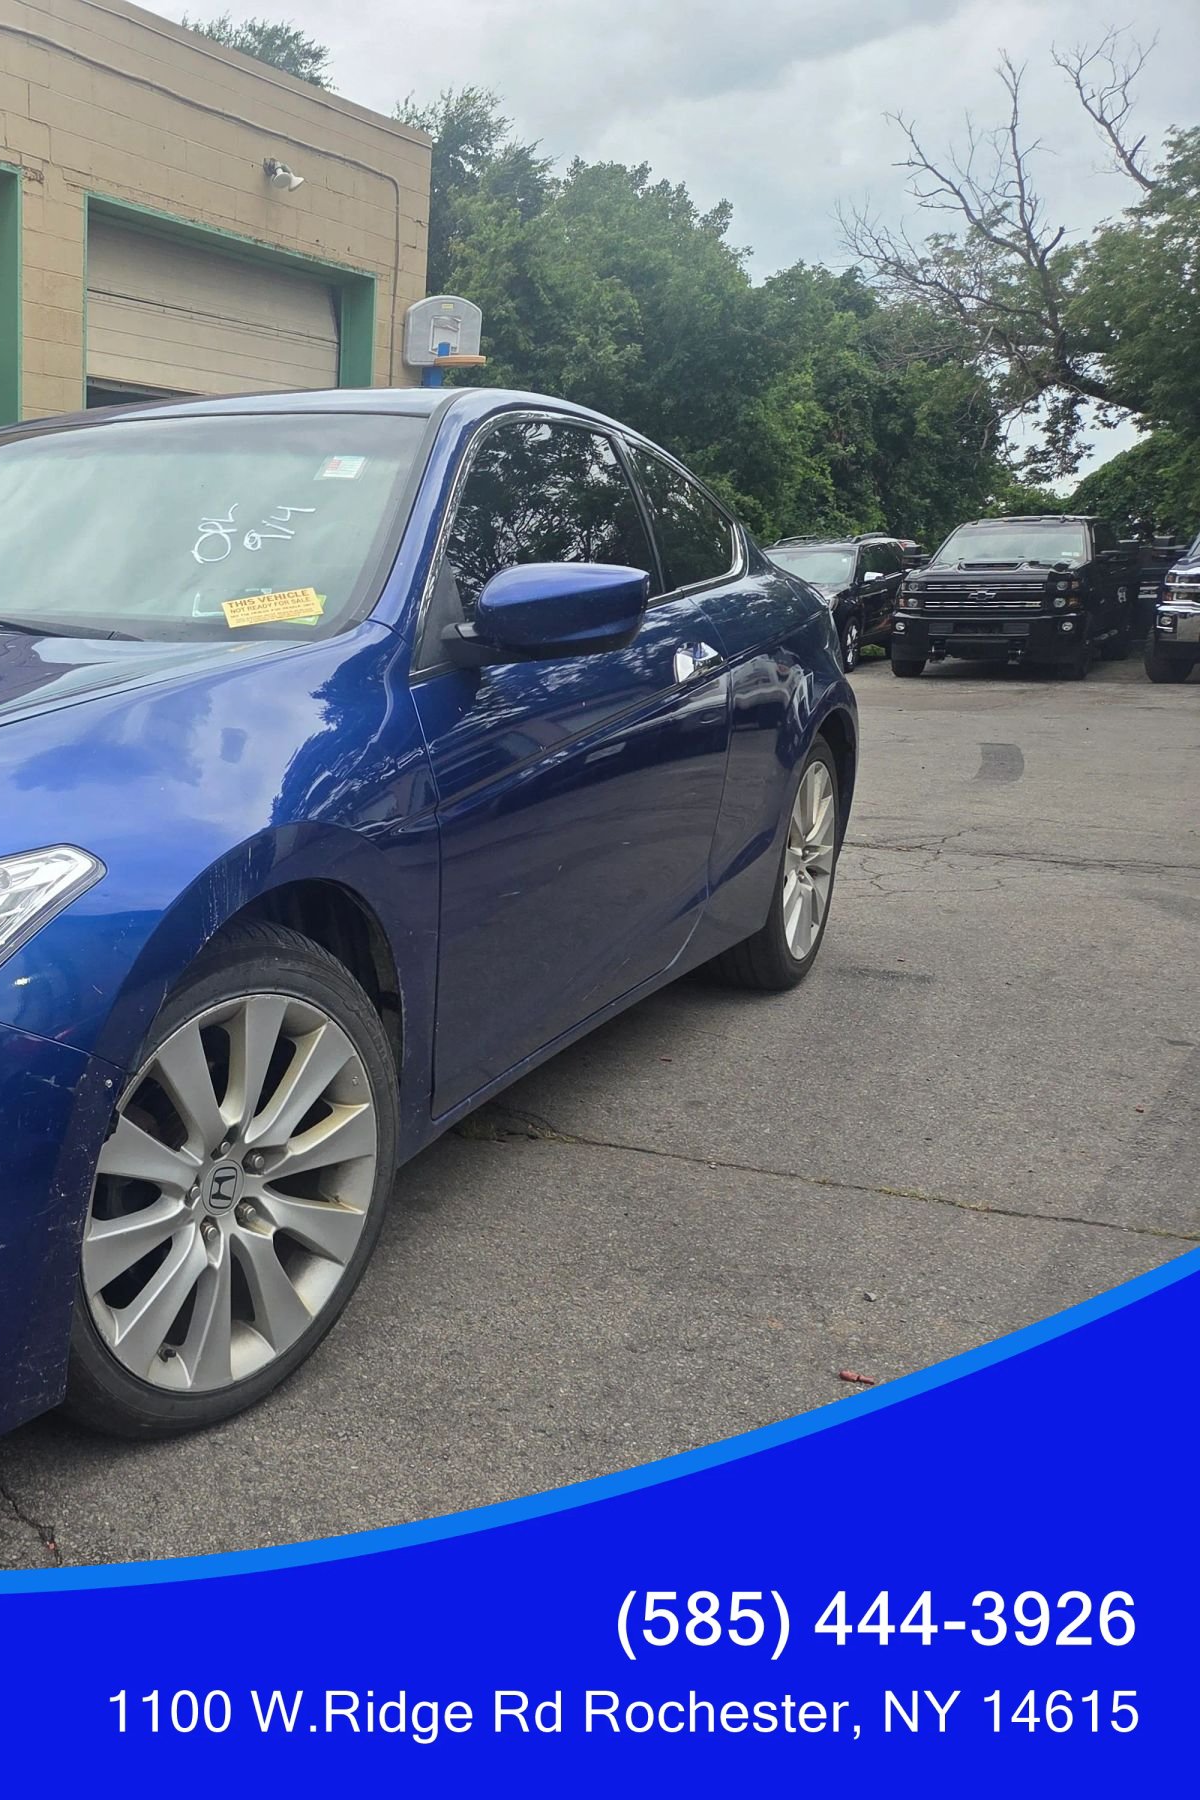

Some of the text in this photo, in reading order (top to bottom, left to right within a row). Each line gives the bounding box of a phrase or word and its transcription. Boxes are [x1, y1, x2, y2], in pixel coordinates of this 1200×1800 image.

[228, 589, 310, 608] THIS VEHICLE
[230, 606, 246, 614] NOT
[247, 602, 272, 612] READY
[274, 599, 290, 608] FOR
[290, 596, 310, 606] SALE
